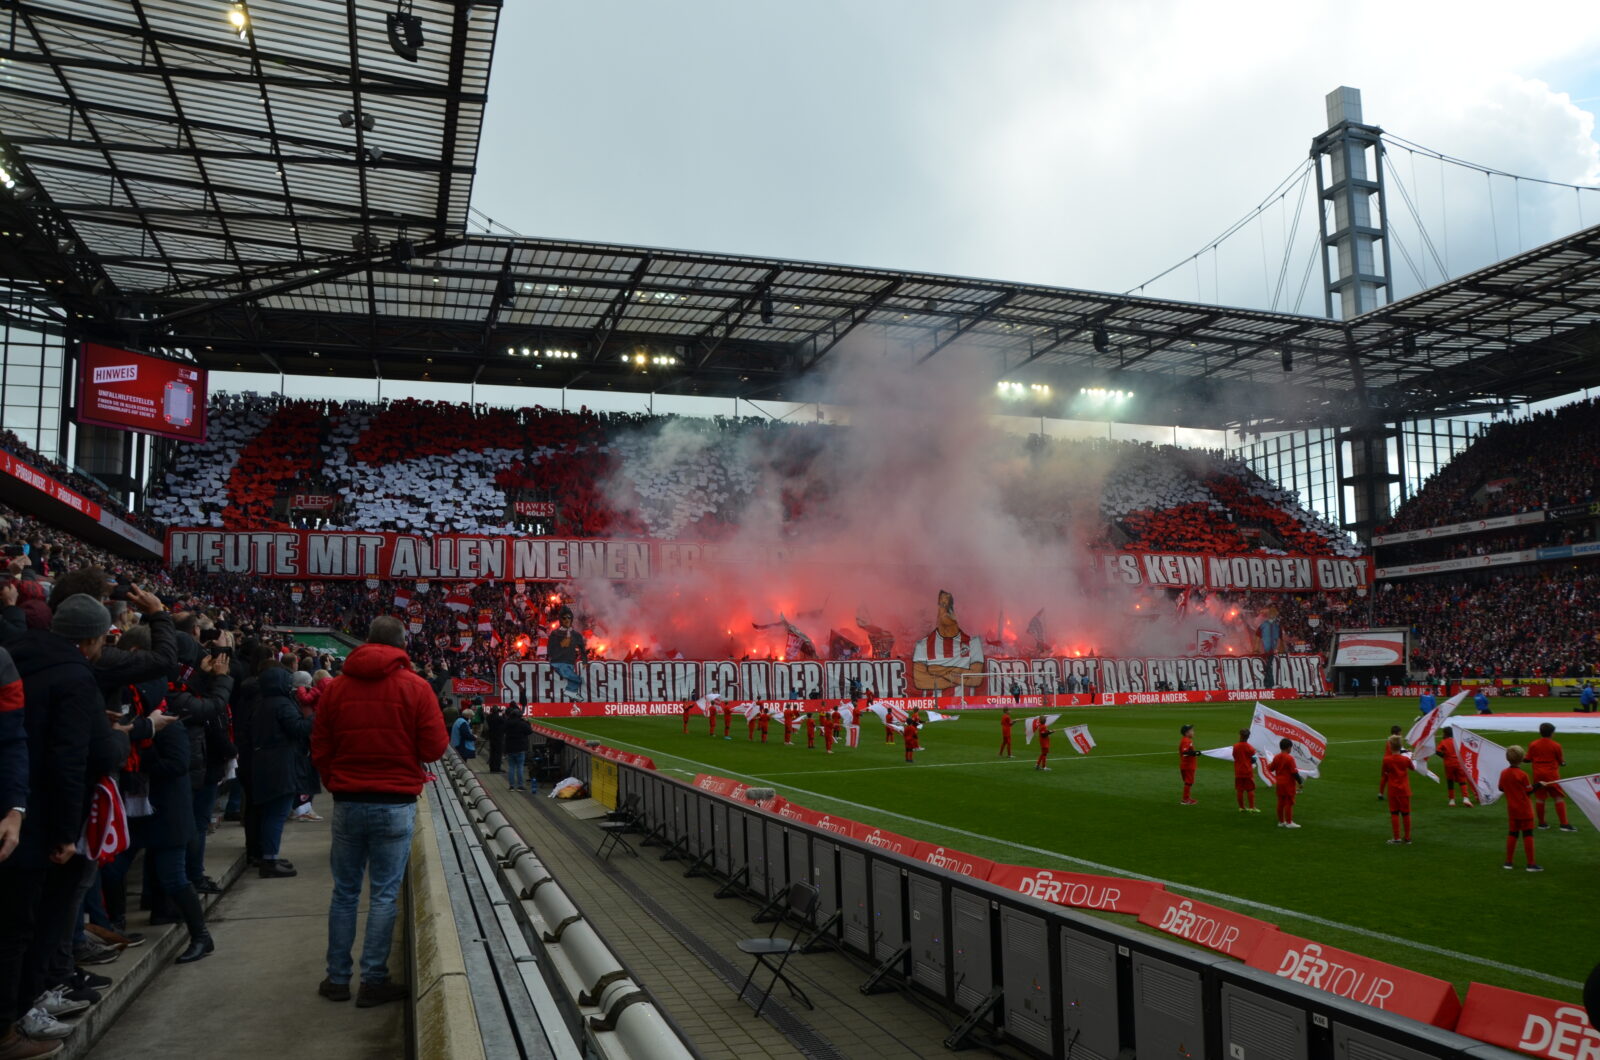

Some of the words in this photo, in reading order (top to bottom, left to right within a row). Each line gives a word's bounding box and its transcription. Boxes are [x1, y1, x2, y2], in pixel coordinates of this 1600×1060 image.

[95, 367, 135, 381] HINWEIS
[515, 502, 555, 514] HAWKS
[171, 531, 300, 576] HEUTE
[308, 533, 385, 576] MIT
[390, 537, 505, 580] ALLEN
[513, 540, 651, 581] MEINEN
[1103, 554, 1142, 586] ES
[1142, 553, 1205, 588] KEIN
[1208, 556, 1313, 590] MORGEN
[1317, 558, 1368, 590] GIBT
[577, 661, 628, 703] ICH
[631, 661, 700, 703] BEIM
[704, 661, 740, 701] FC
[741, 661, 771, 700] IN
[773, 661, 824, 700] DER
[987, 658, 1029, 696] DER
[1064, 658, 1100, 694] IST
[1101, 658, 1144, 694] DAS
[1146, 657, 1221, 692] EINZIGE
[1221, 657, 1266, 691] WAS
[605, 702, 646, 715] SPÜRBAR
[1128, 692, 1159, 703] SPÜRBAR
[1228, 690, 1257, 701] SPÜRBAR
[1019, 874, 1121, 910] DERTOUR
[1160, 903, 1240, 953] DERTOUR
[1276, 948, 1394, 1010] DERTOUR
